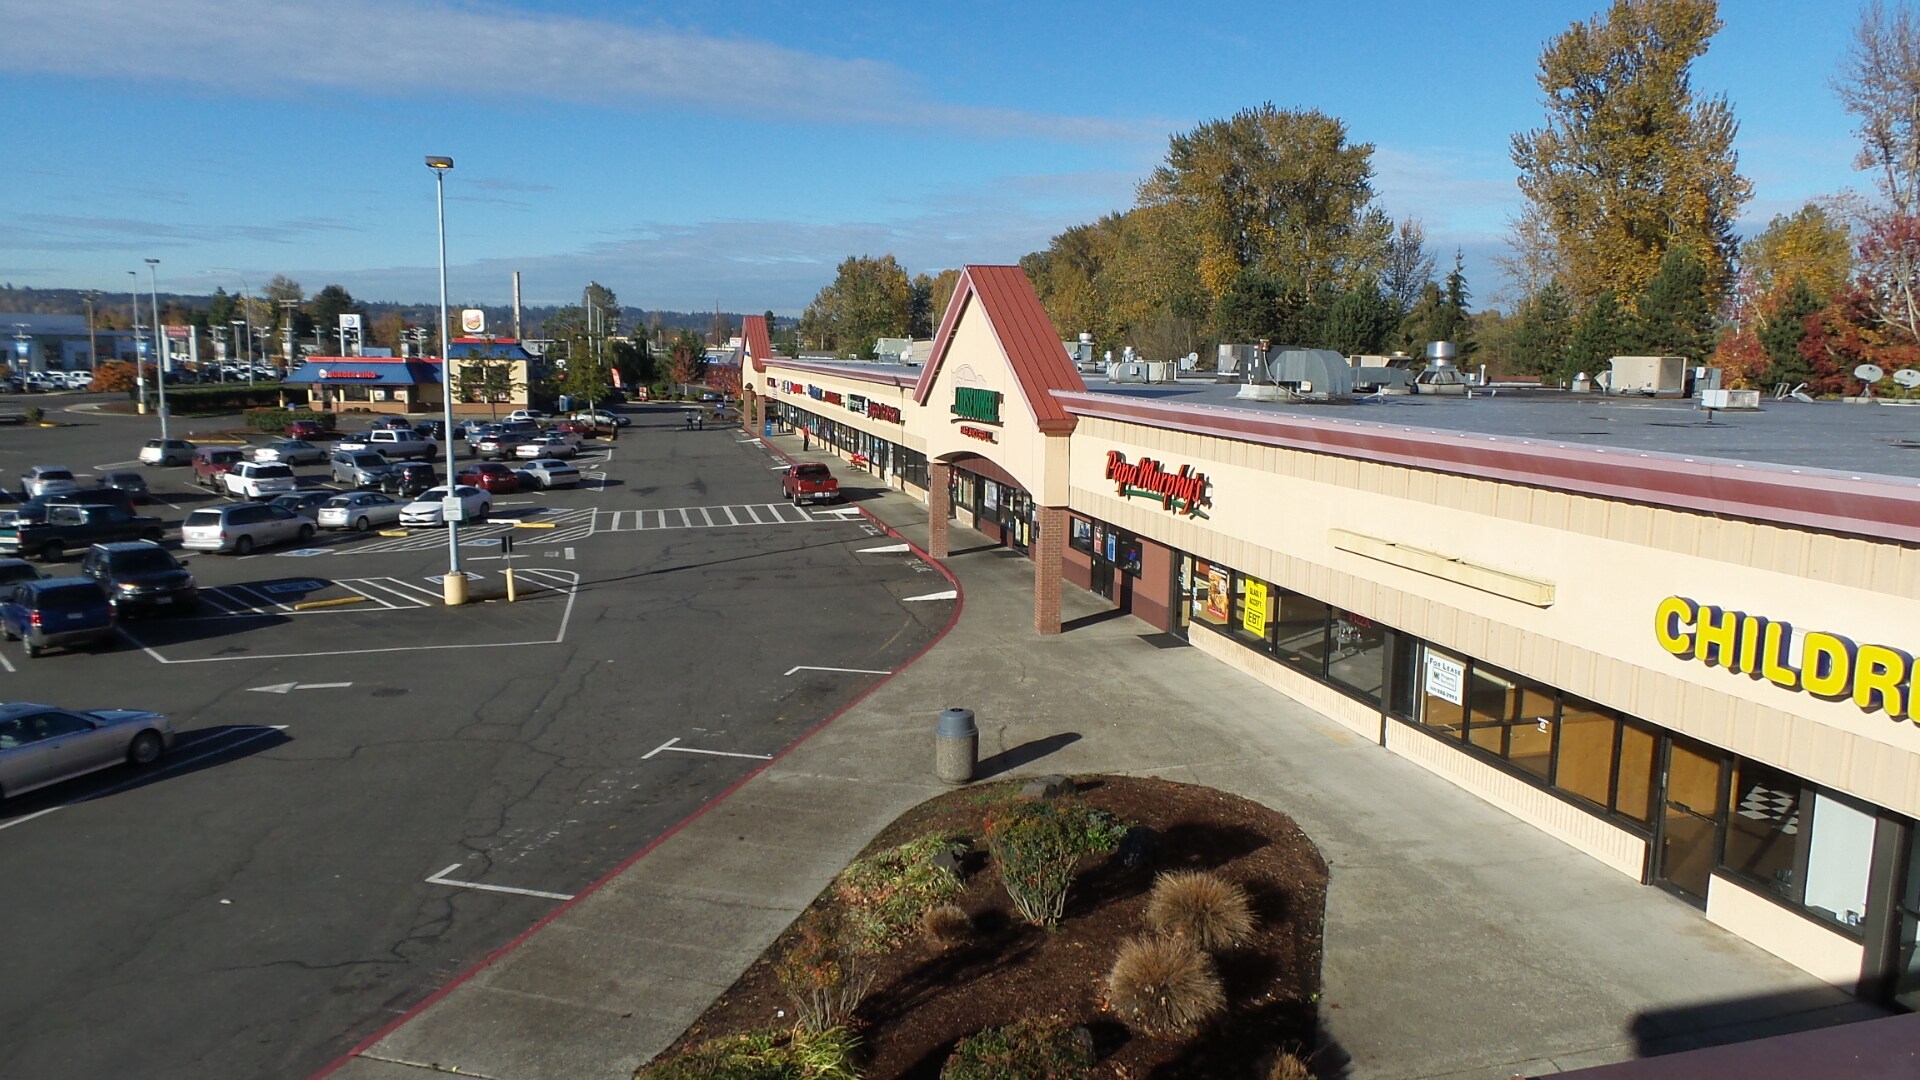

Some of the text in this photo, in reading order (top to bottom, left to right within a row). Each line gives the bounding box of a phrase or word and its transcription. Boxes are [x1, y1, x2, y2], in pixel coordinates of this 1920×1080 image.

[1105, 450, 1203, 515] Papa Murphy's
[1248, 611, 1261, 627] EBT
[1442, 662, 1461, 676] LEASE
